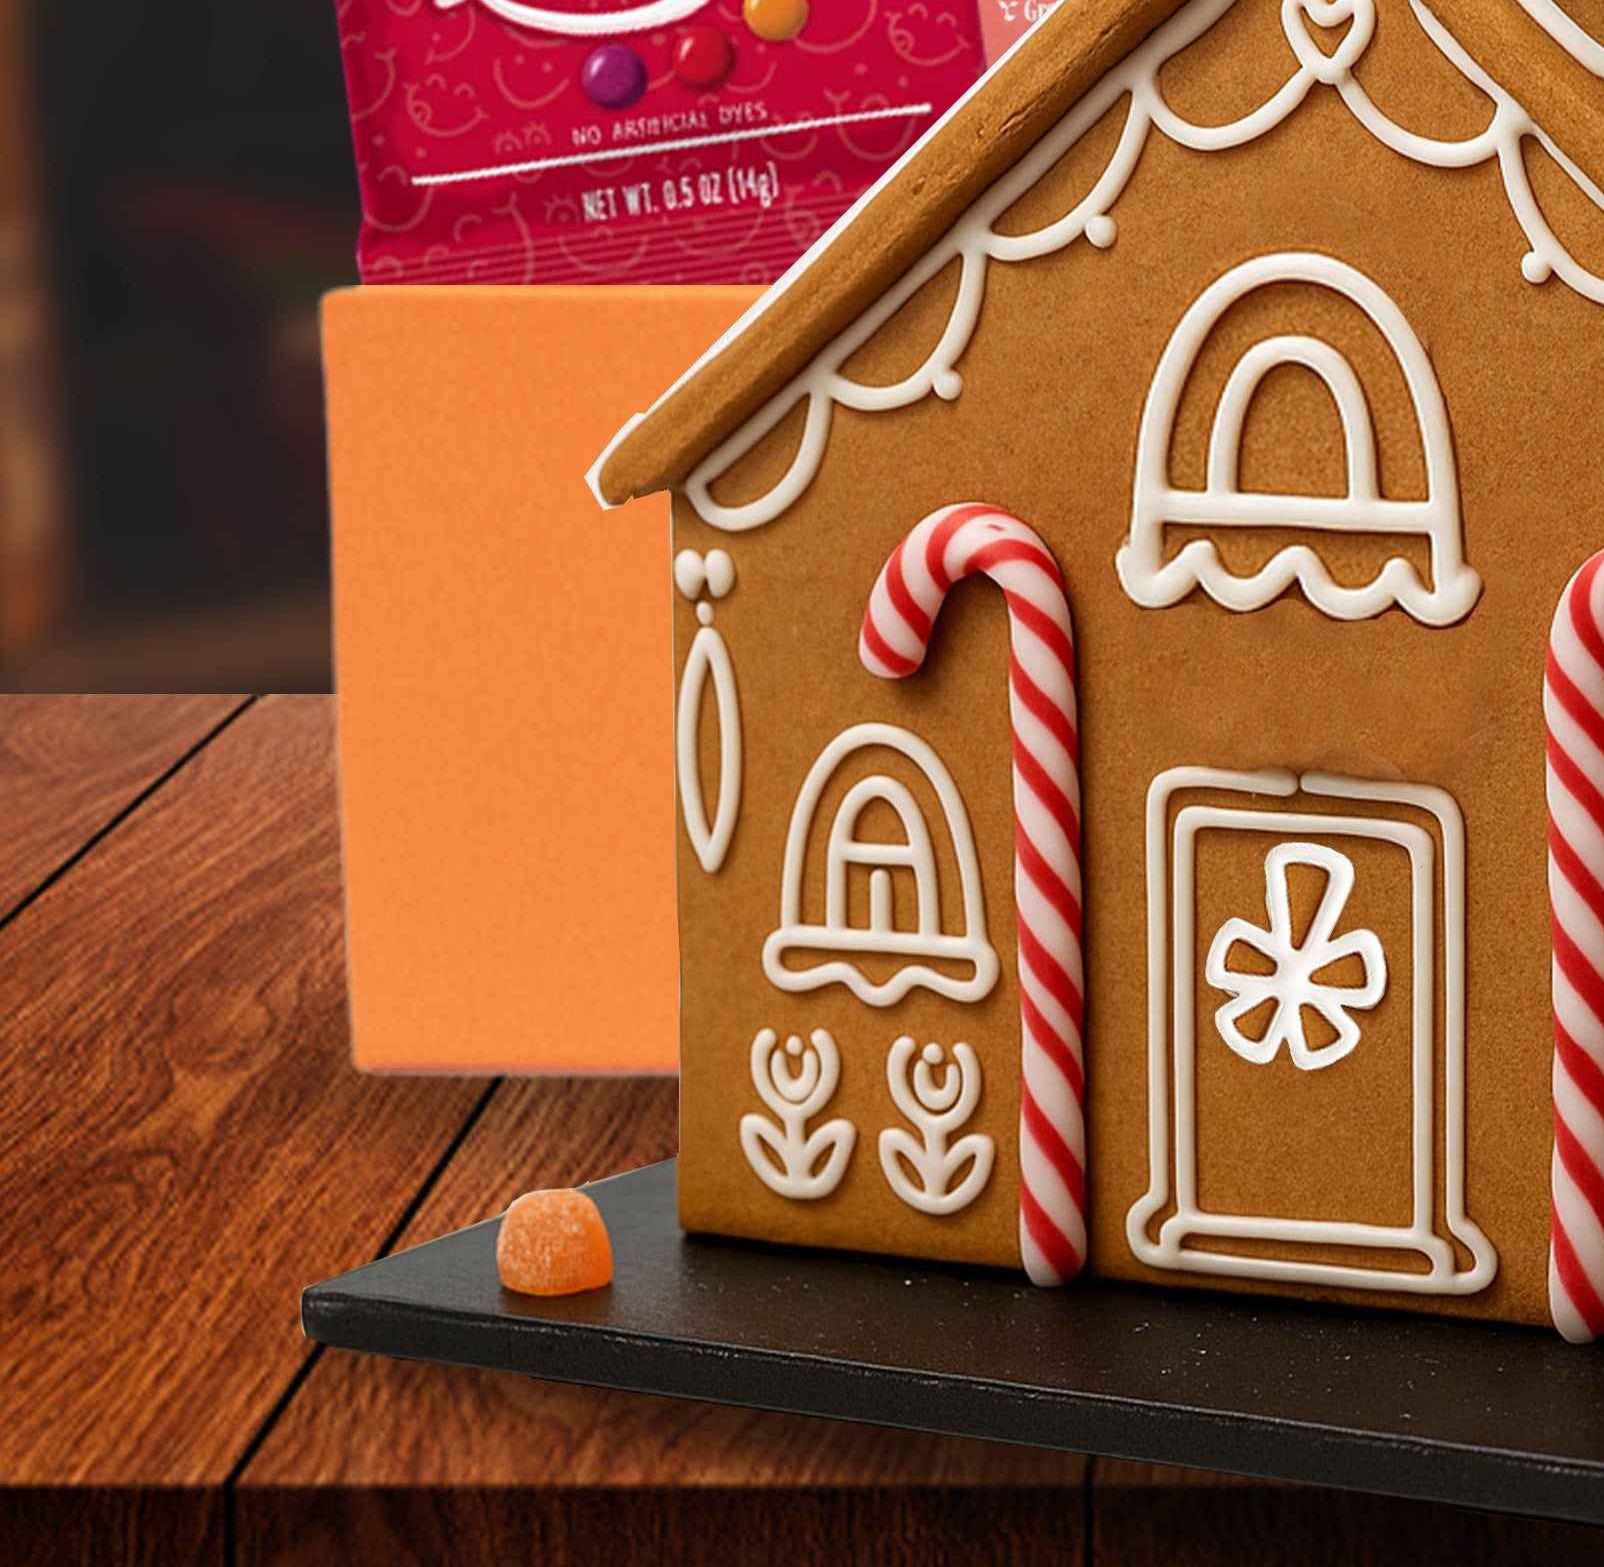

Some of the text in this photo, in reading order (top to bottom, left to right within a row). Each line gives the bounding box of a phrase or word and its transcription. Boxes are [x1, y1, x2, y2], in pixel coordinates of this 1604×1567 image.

[571, 125, 601, 147] NO
[719, 101, 768, 125] DYES
[581, 187, 617, 222] NET
[621, 181, 660, 218] WT.
[662, 176, 695, 210] 0.5
[727, 160, 780, 209] (14g)
